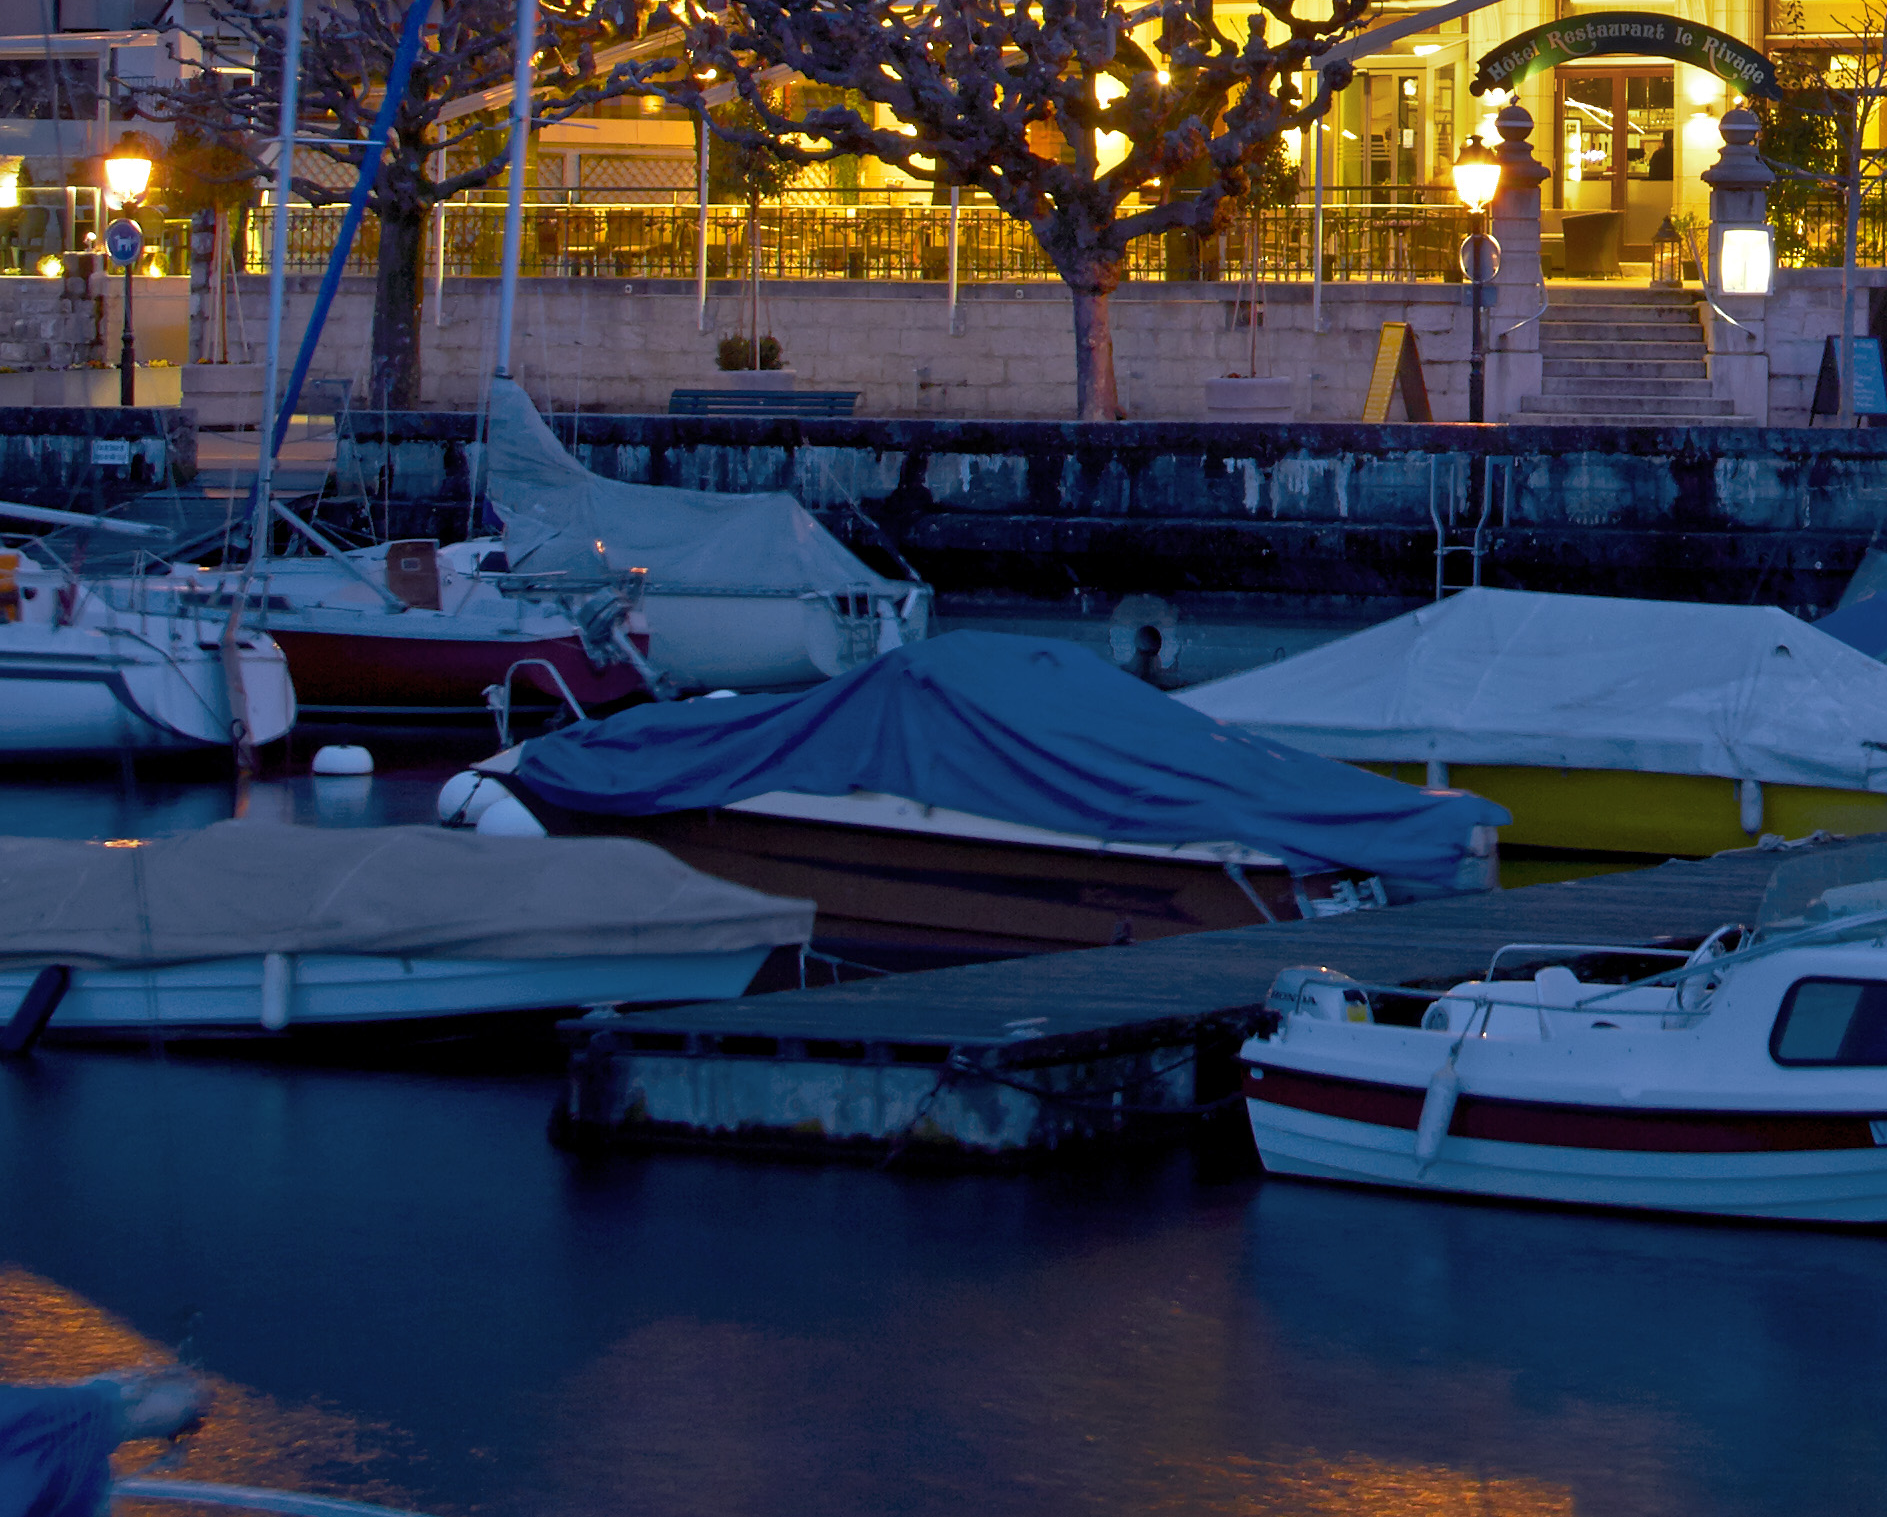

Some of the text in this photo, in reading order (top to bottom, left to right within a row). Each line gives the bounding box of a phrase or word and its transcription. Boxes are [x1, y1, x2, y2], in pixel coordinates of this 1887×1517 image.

[1486, 20, 1765, 86] Hôtel Restaurant le Rivage
